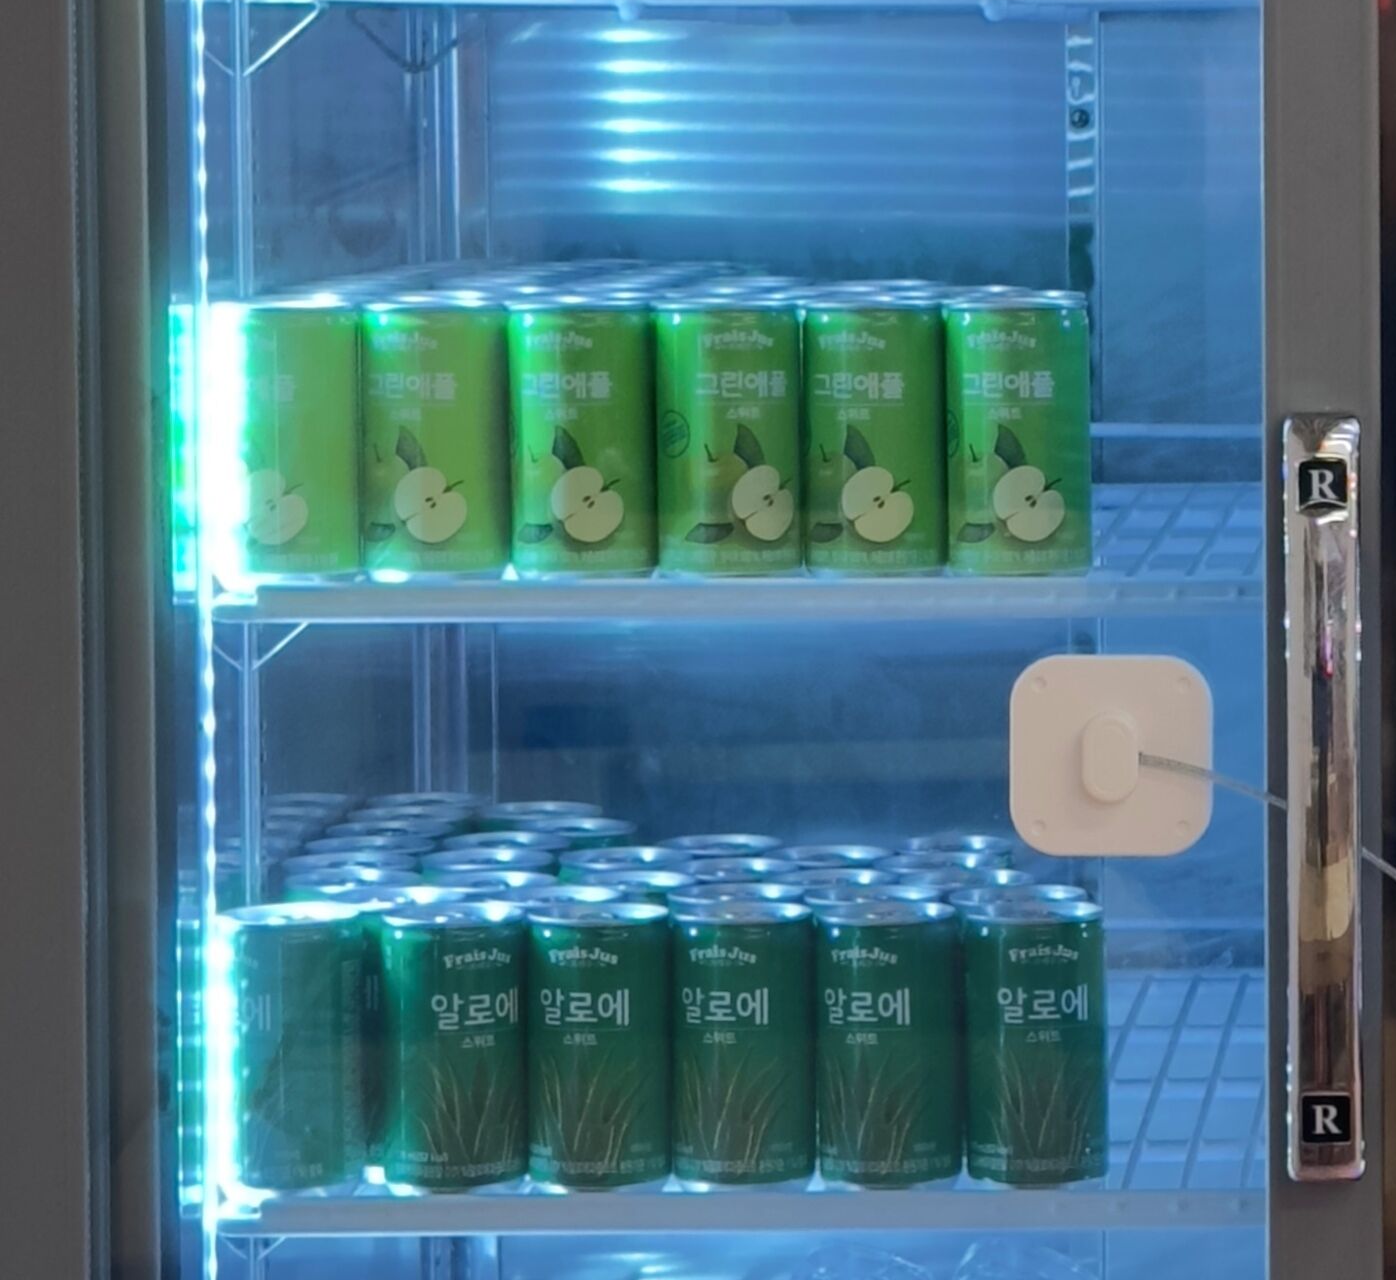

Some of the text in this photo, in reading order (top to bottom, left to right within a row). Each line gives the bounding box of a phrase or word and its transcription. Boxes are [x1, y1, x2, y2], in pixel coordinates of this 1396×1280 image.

[368, 372, 457, 400] 그린애플
[521, 371, 612, 399] 그린애플
[694, 370, 788, 399] 그린애플
[812, 370, 905, 400] 그린애플
[962, 370, 1056, 400] 그린애플
[1309, 469, 1339, 500] R
[547, 947, 619, 967] FraisJus
[689, 944, 758, 965] FraisJus
[831, 944, 899, 965] FraisJus
[1008, 943, 1080, 964] FraisJus
[430, 985, 518, 1031] 알로에
[540, 987, 630, 1026] 알로에
[682, 986, 769, 1025] 알로에
[824, 986, 911, 1025] 알로에
[996, 983, 1090, 1025] 알로에
[462, 1034, 495, 1049] 스위트
[562, 1032, 598, 1046] 스위트
[702, 1030, 737, 1045] 스위트
[845, 1030, 879, 1045] 스위트
[1025, 1029, 1062, 1043] 스위트
[1312, 1104, 1342, 1135] R
